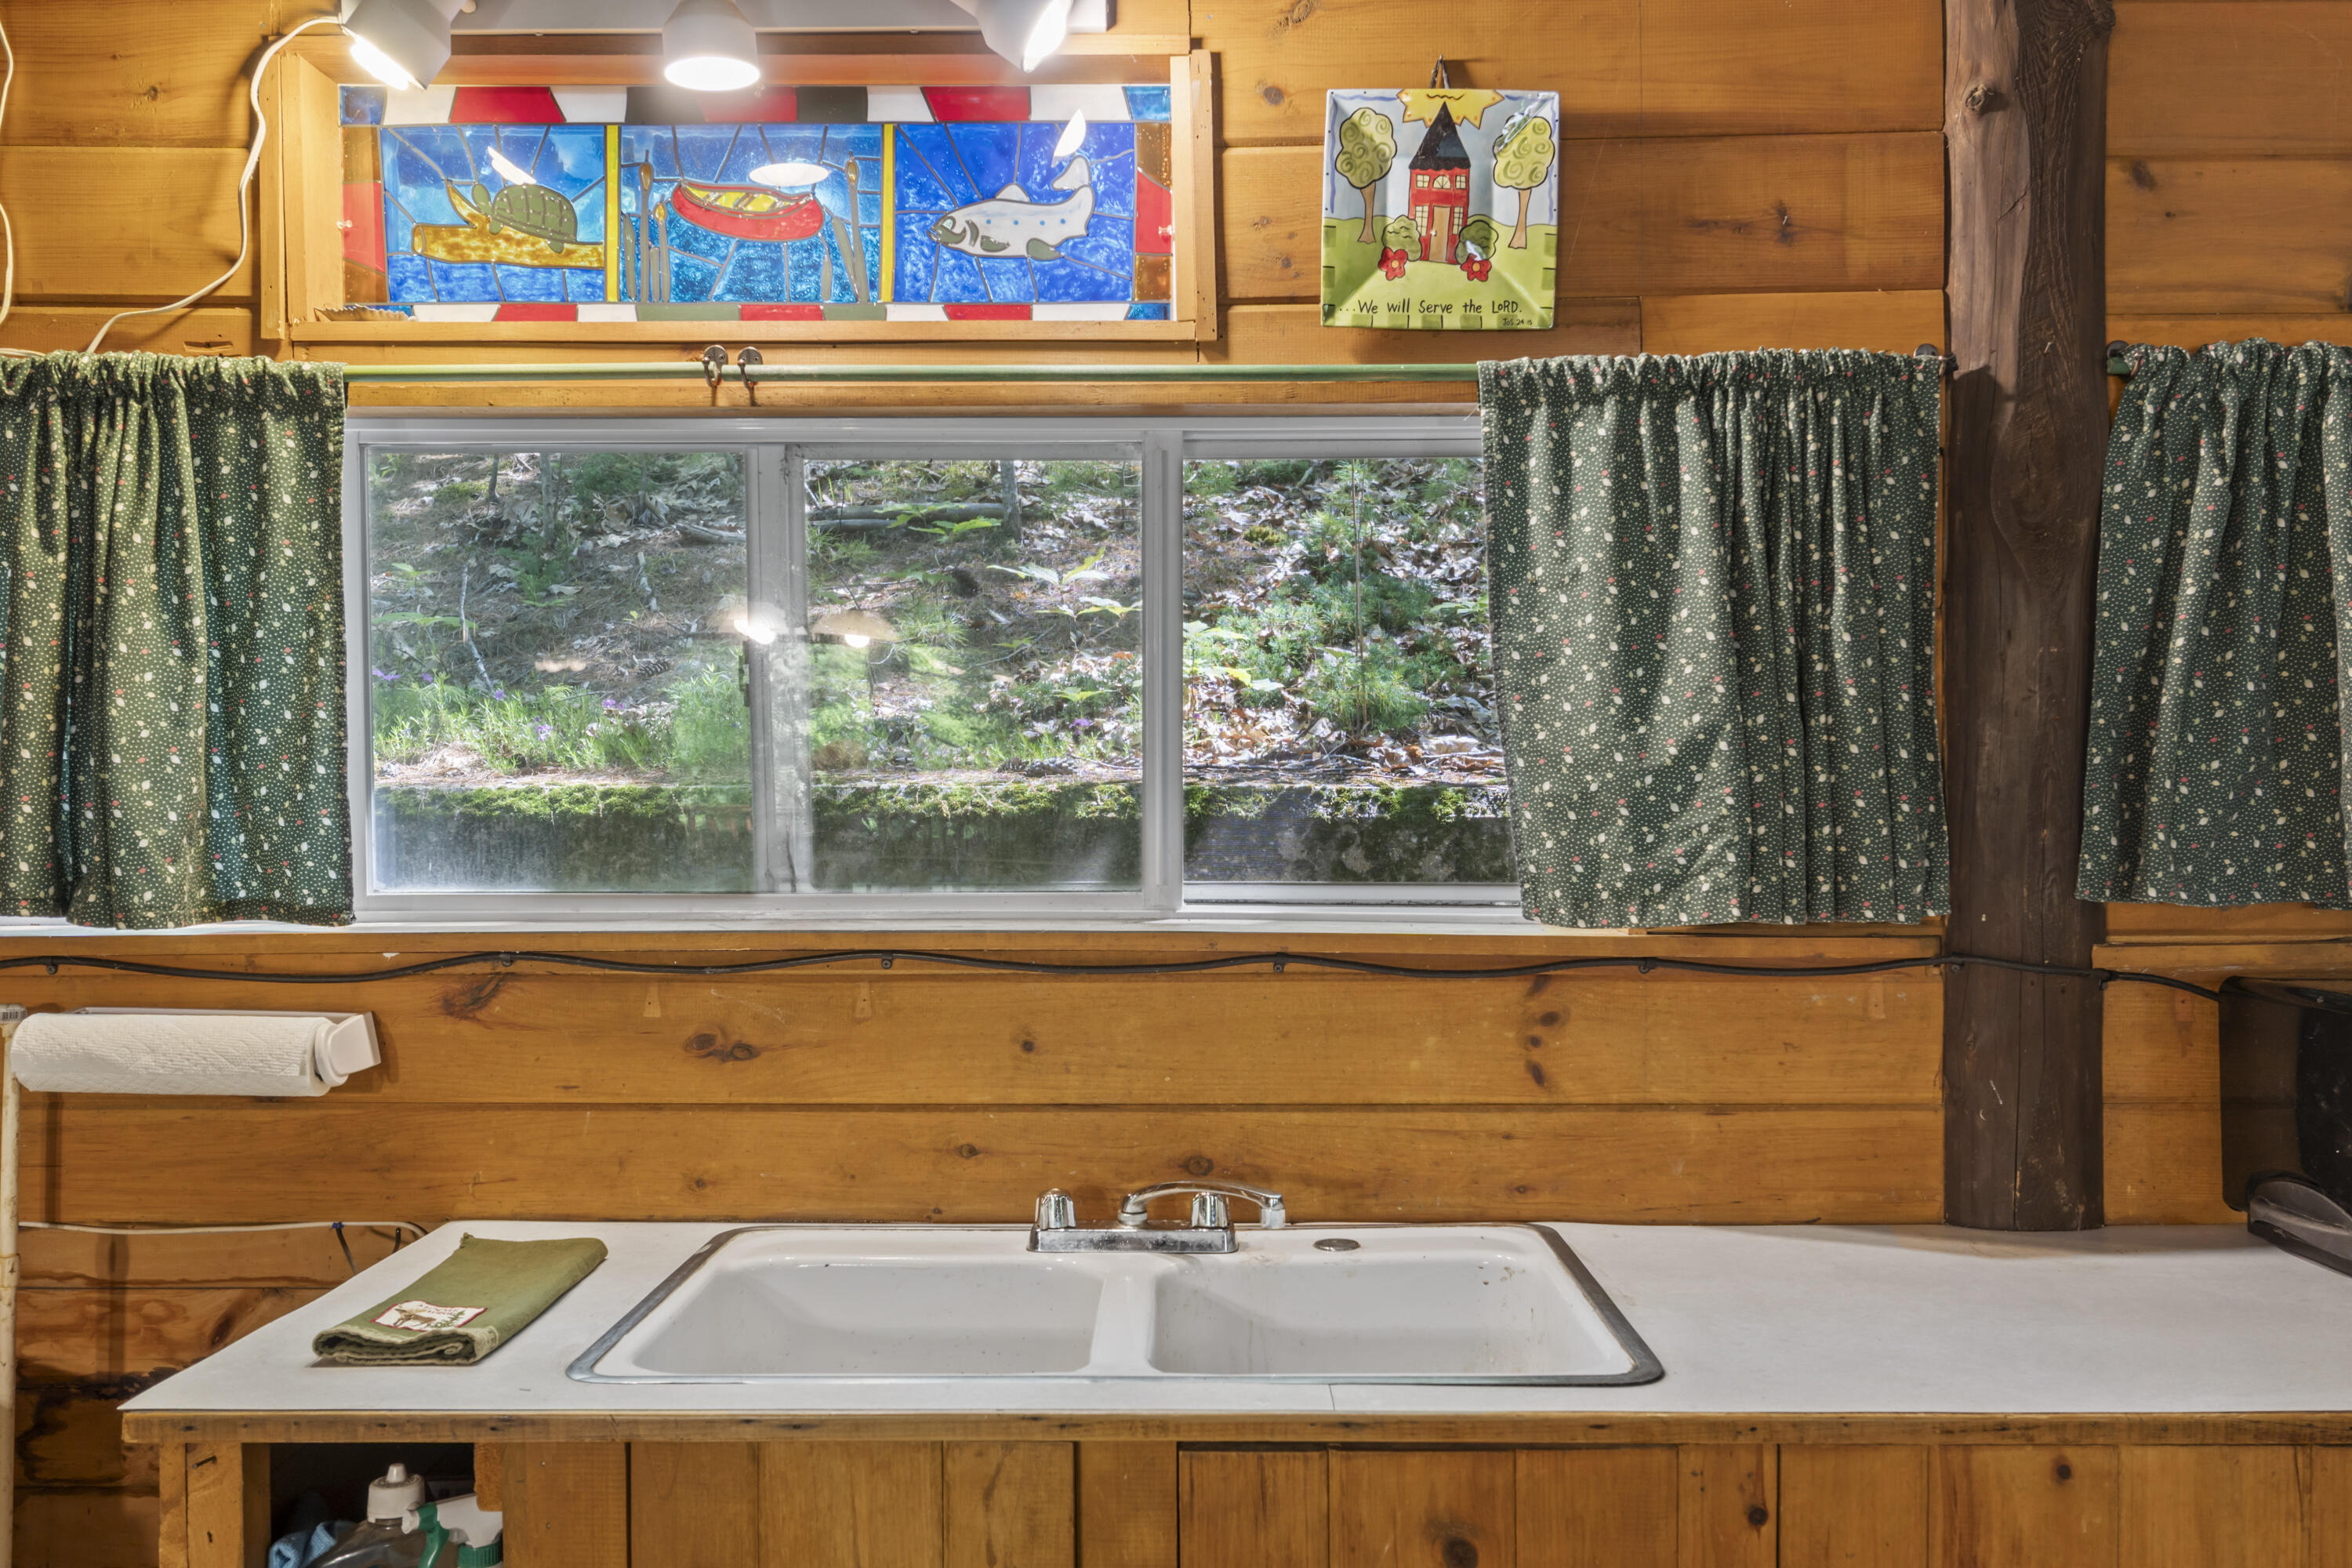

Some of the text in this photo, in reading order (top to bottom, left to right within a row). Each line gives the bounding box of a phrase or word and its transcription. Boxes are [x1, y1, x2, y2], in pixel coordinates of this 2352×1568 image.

[1387, 297, 1410, 313] will
[1418, 299, 1453, 314] Serve
[1462, 299, 1482, 314] the
